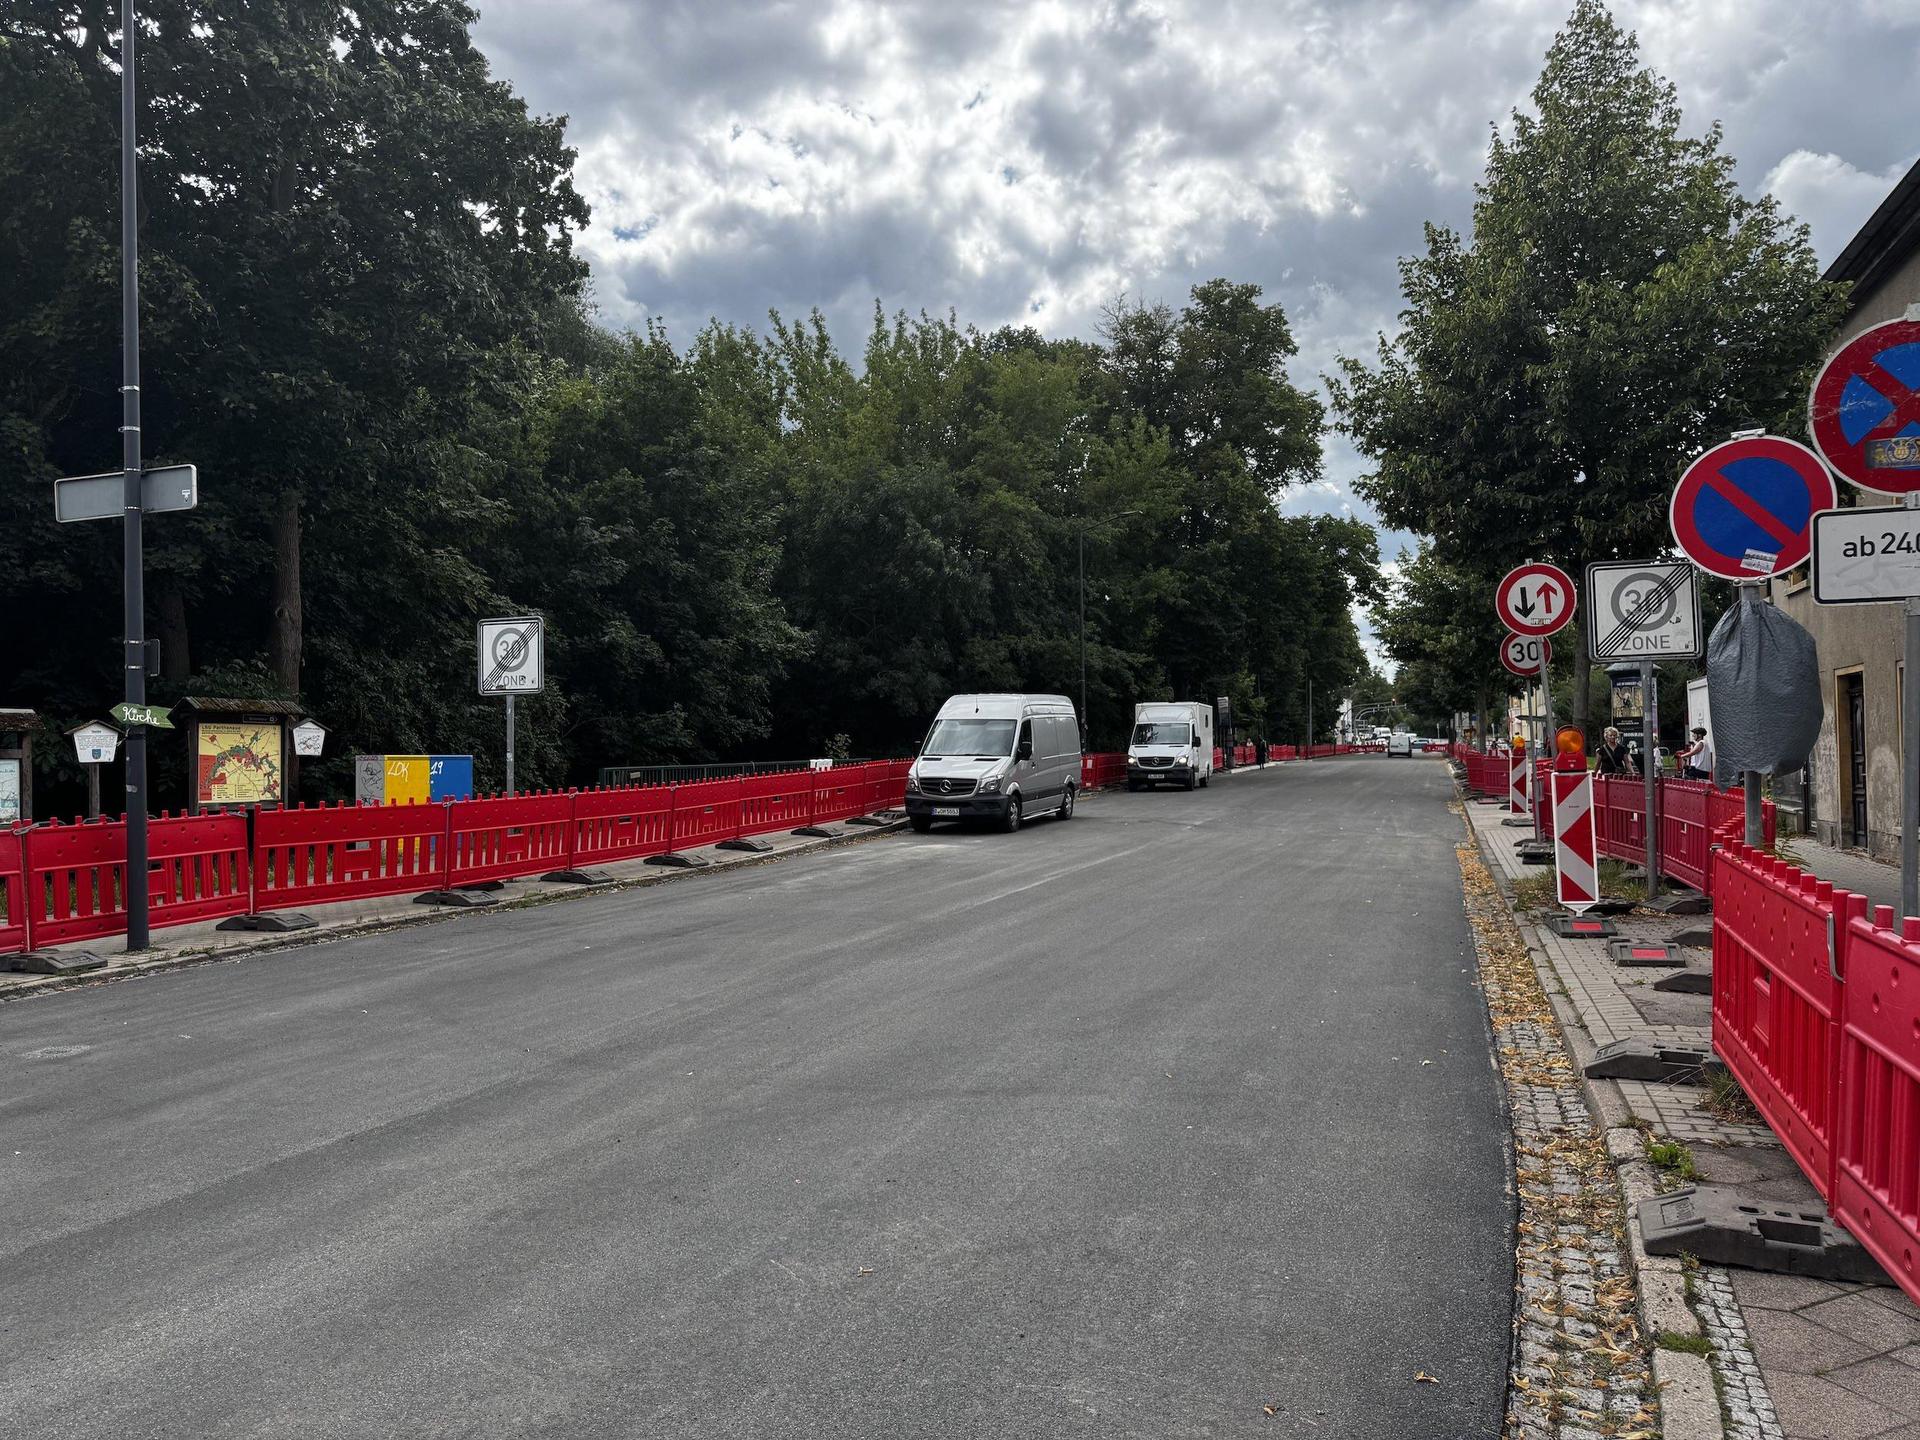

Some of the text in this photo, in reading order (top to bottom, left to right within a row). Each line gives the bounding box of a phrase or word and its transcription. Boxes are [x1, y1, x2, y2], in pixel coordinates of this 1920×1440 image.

[1842, 531, 1920, 558] ab 24.
[1511, 640, 1539, 663] 30
[1621, 634, 1672, 651] ZONE
[122, 706, 160, 725] Kirche
